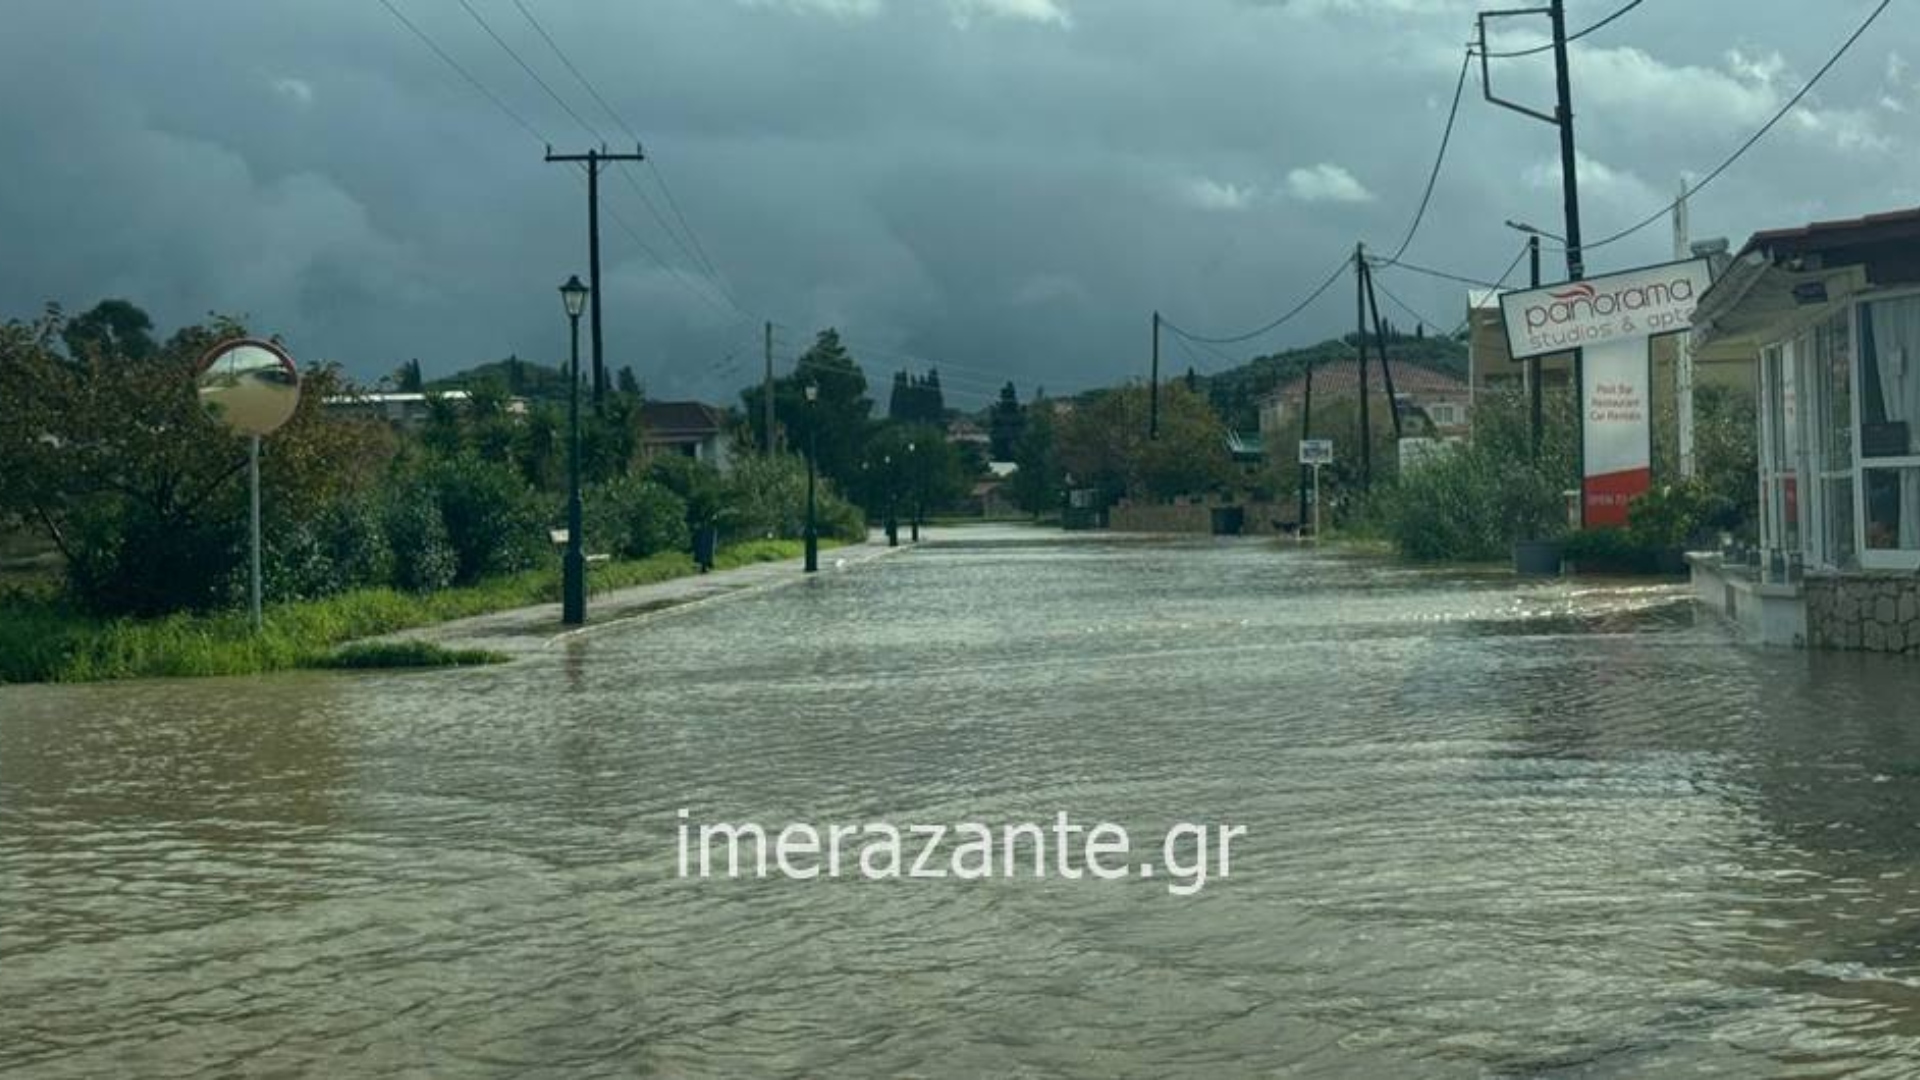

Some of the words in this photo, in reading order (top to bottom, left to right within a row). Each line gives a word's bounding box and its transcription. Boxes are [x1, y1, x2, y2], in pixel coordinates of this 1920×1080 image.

[1525, 278, 1693, 334] panorama
[1530, 321, 1612, 349] studios
[1621, 315, 1636, 332] &
[1619, 383, 1632, 393] Bar
[1591, 398, 1639, 408] Restaurant
[1590, 411, 1605, 421] Car
